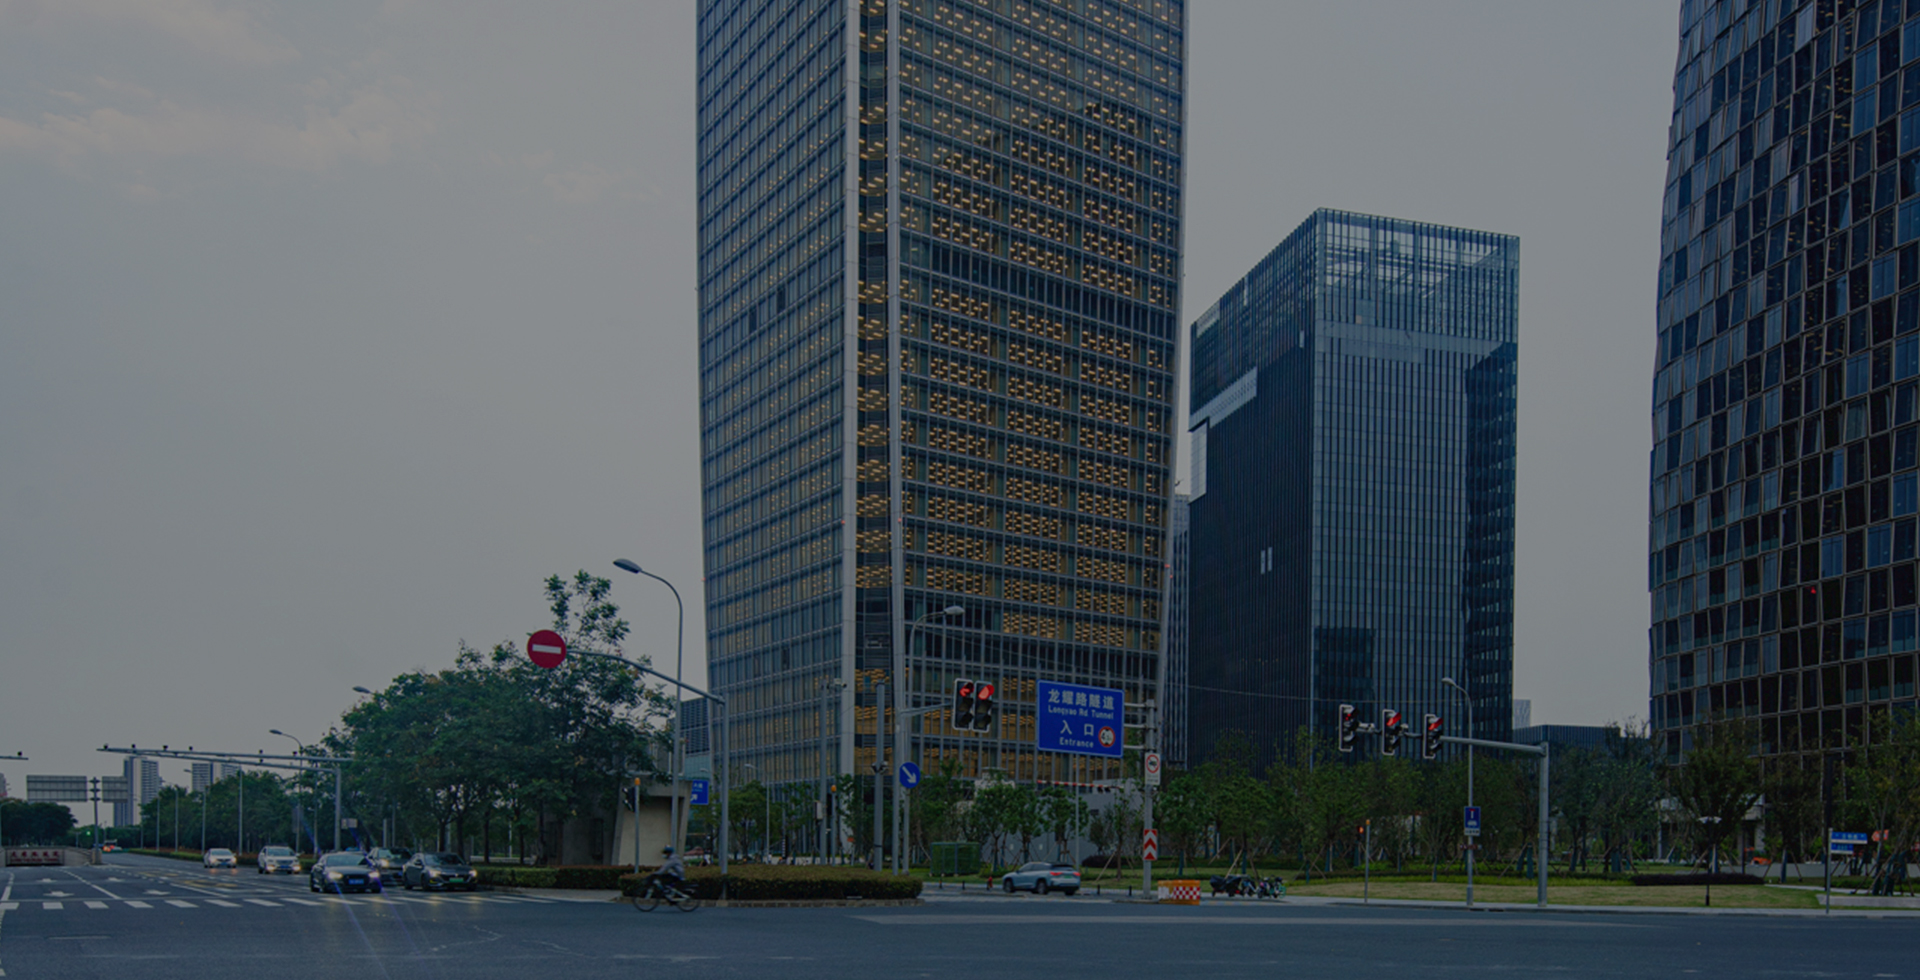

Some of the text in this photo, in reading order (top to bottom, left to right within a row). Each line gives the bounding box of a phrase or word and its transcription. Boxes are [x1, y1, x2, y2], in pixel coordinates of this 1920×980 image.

[1048, 689, 1114, 710] 龙耀路隧道
[1048, 705, 1077, 716] Longyao
[1091, 709, 1114, 720] Tunnel
[1060, 720, 1094, 736] 入口
[1059, 737, 1094, 748] Entrance
